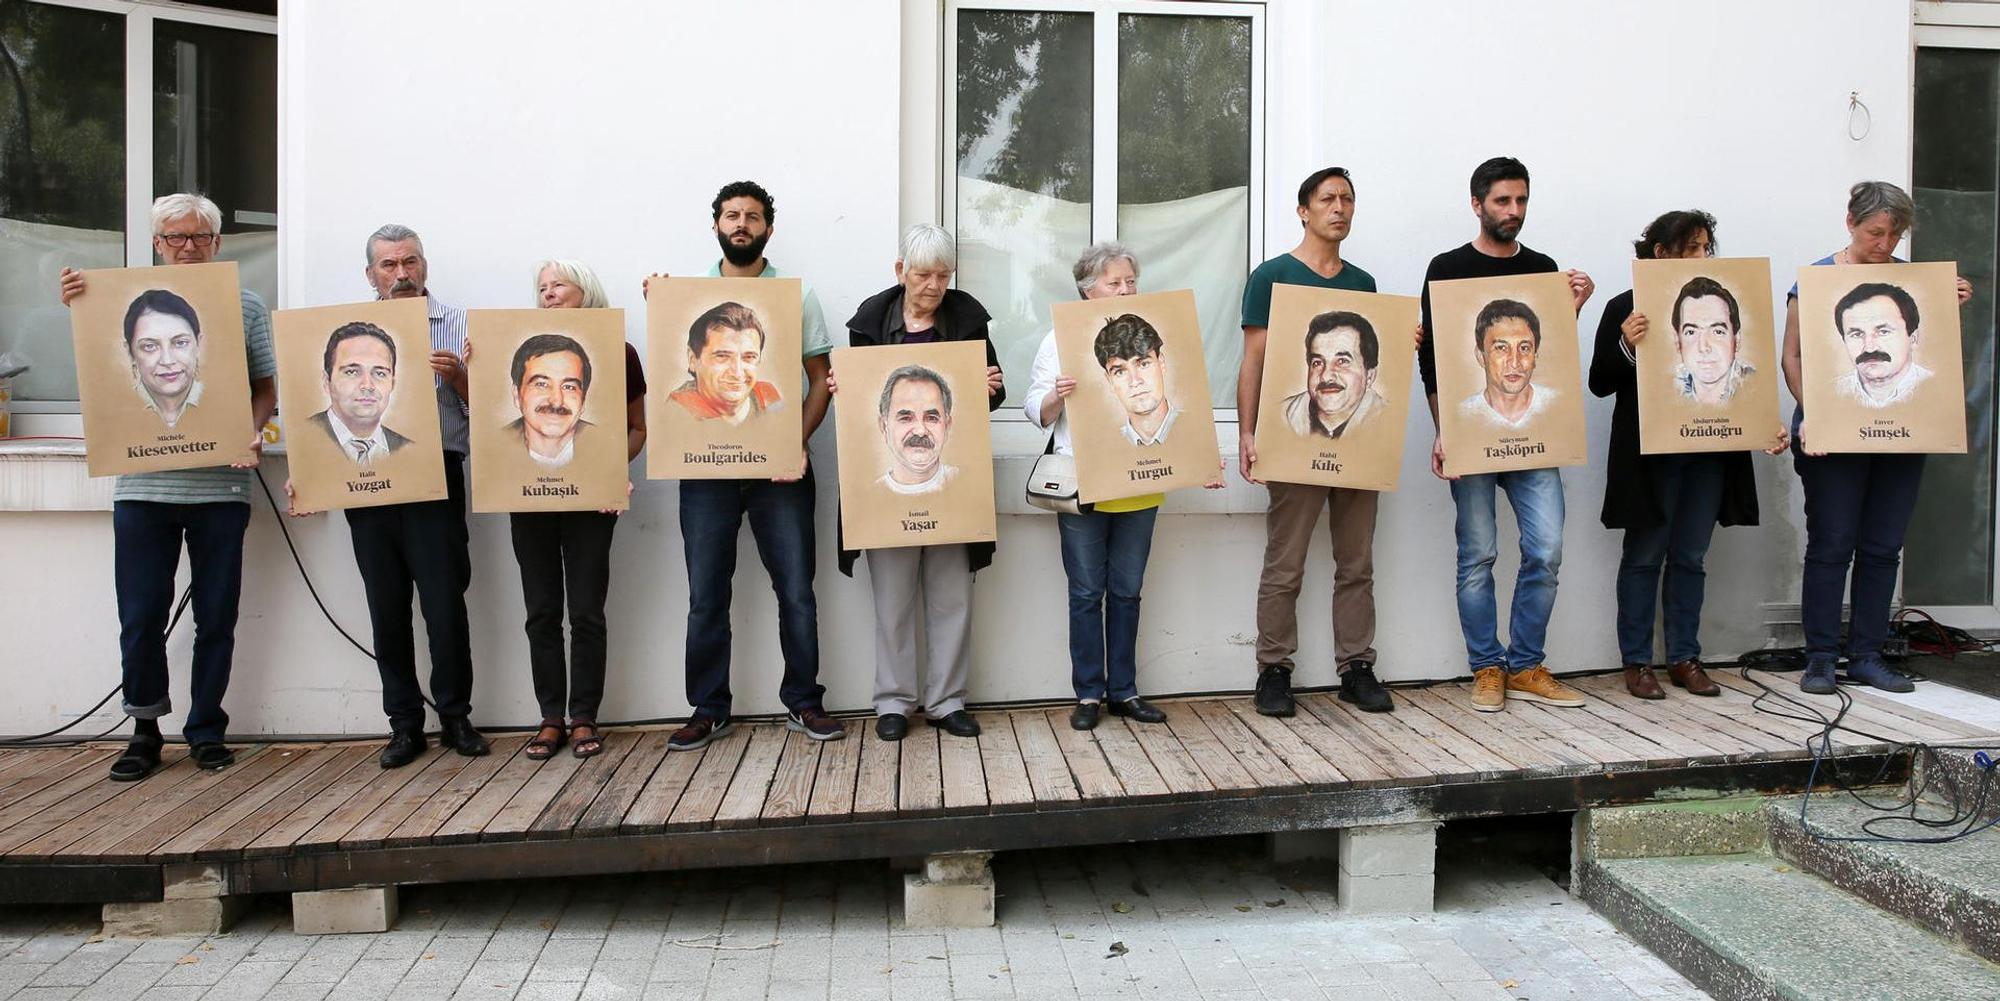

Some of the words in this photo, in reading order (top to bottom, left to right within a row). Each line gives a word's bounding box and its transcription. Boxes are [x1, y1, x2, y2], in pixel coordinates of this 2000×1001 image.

[1680, 424, 1742, 439] Özüdoğru
[1860, 427, 1911, 440] Şimşek
[128, 440, 217, 458] Kiesewetter
[1484, 442, 1546, 459] Taşköprü
[684, 452, 767, 466] Boulgarides
[1137, 457, 1162, 467] Mehmet
[1312, 459, 1342, 474] Kılıç
[1128, 466, 1174, 481] Turgut
[346, 477, 392, 493] Yozgat
[523, 484, 580, 499] Kubaşık
[901, 519, 938, 533] Yaşar
